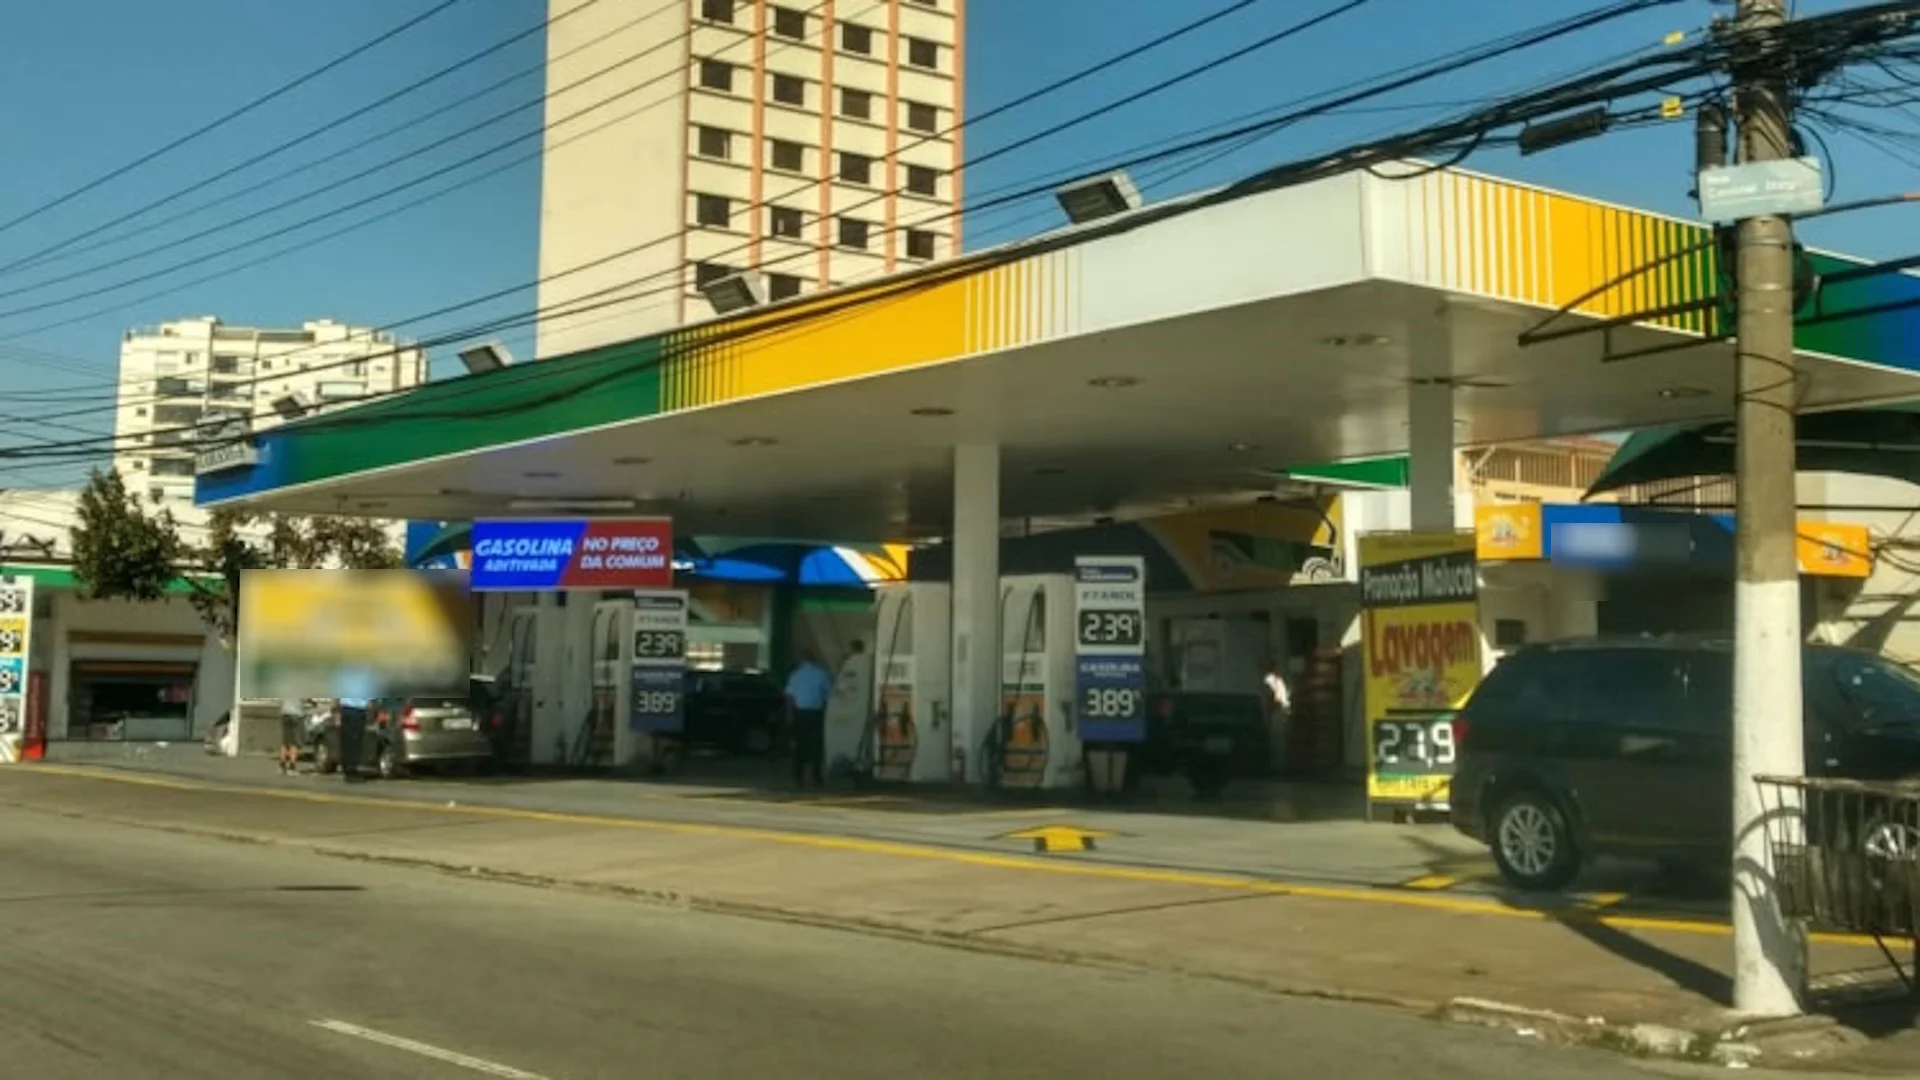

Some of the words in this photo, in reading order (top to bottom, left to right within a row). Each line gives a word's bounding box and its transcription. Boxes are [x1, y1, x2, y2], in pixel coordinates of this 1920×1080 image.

[475, 538, 573, 556] GASOLINA
[583, 537, 608, 551] NO
[611, 537, 659, 554] PREÇO
[580, 555, 602, 570] DA
[606, 554, 665, 569] COMUM
